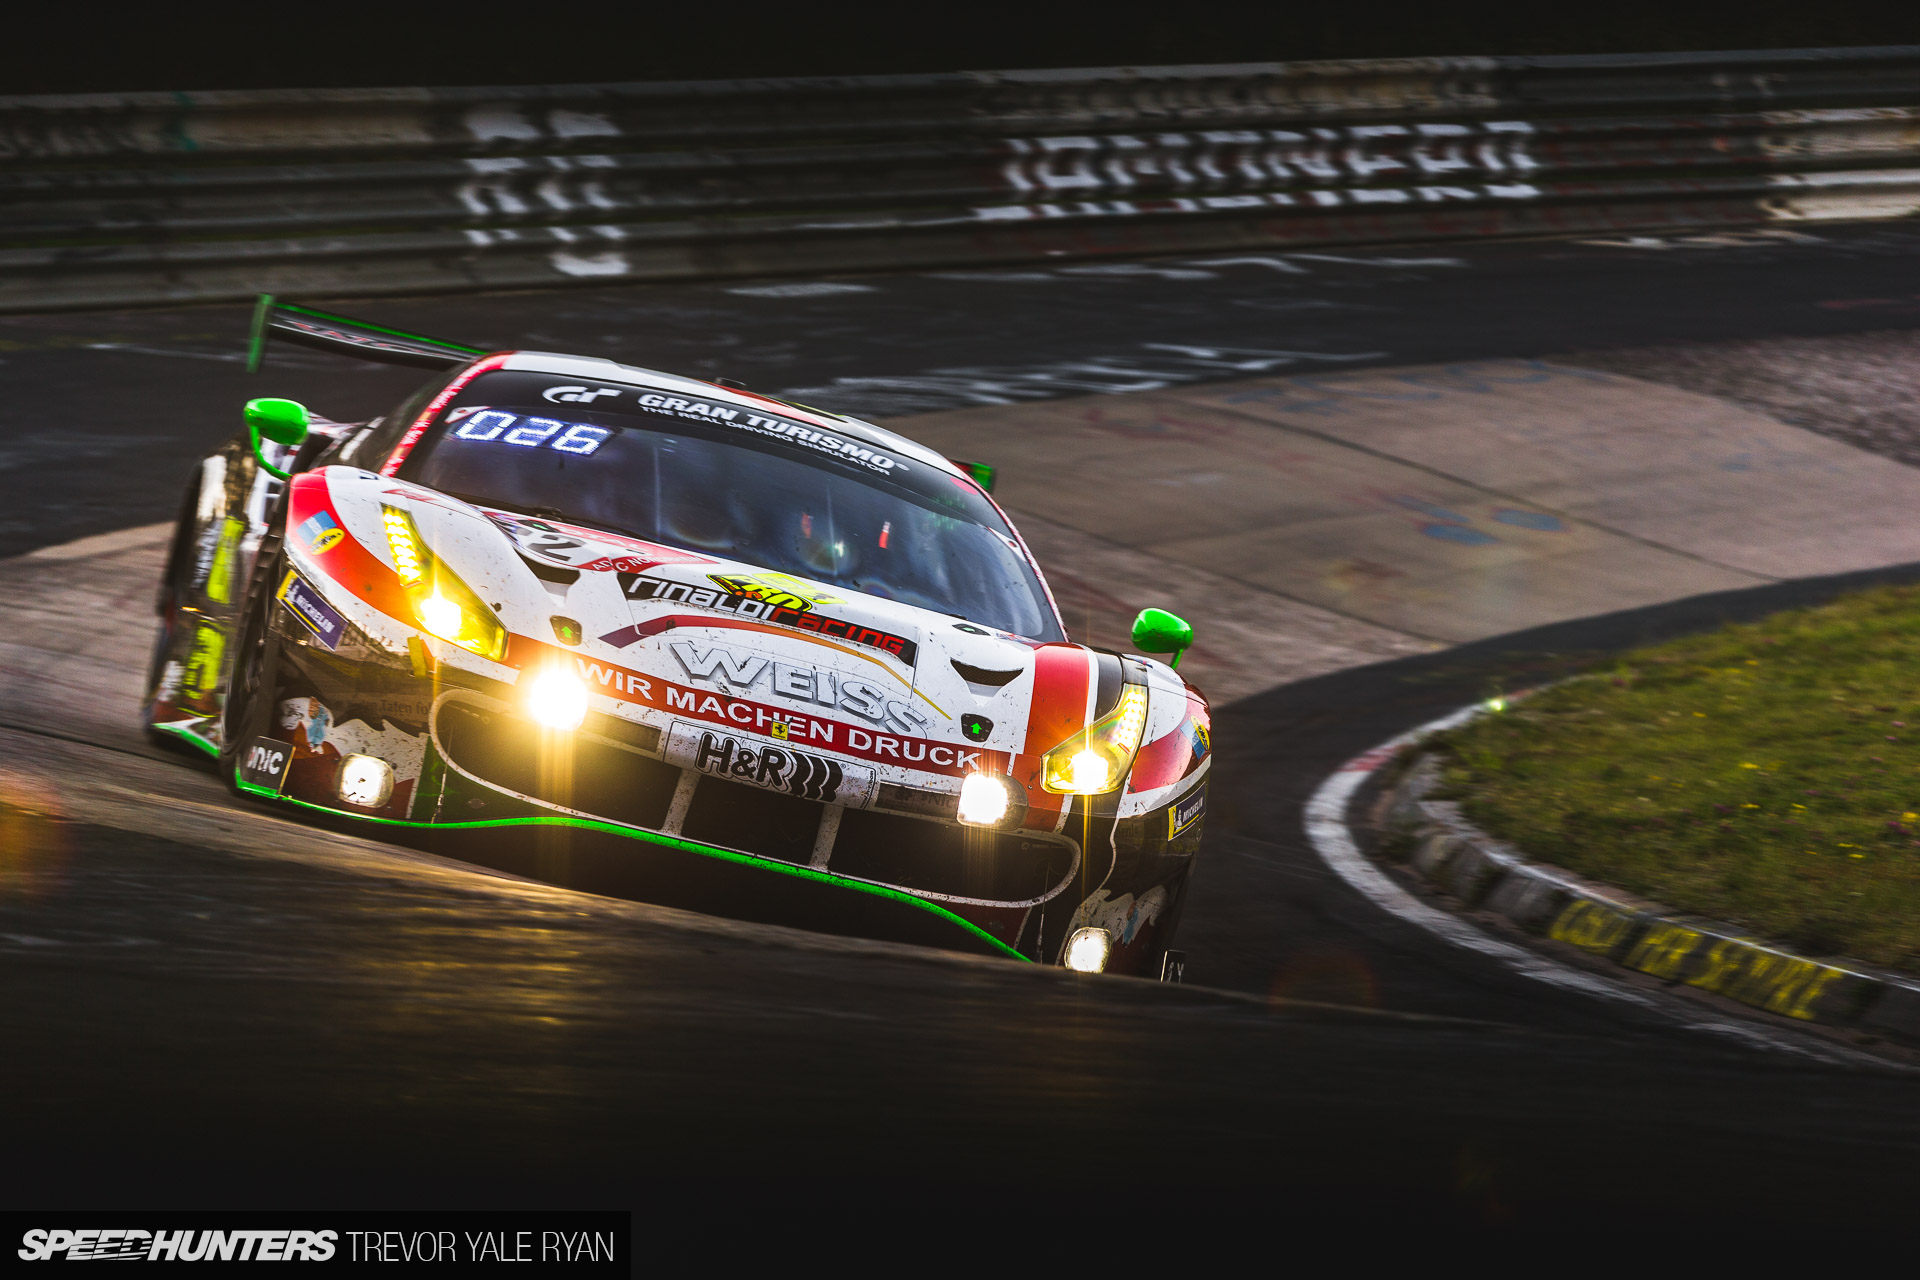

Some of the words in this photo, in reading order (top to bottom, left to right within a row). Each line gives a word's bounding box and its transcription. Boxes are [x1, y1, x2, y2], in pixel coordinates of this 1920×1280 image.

[455, 409, 609, 454] 026
[638, 393, 738, 421] GRAN
[747, 414, 902, 469] TURISMO
[640, 406, 675, 417] THE
[677, 411, 722, 425] REAL
[726, 421, 794, 442] DRIVING
[797, 439, 891, 476] SIMULATOR
[296, 594, 335, 633] MICHELIN
[576, 658, 653, 700] WIR
[666, 687, 834, 743] MACHEN
[848, 728, 981, 771] DRUCK
[670, 642, 927, 740] WEISS
[698, 732, 790, 789] H&R
[1183, 796, 1203, 822] MICHELIN
